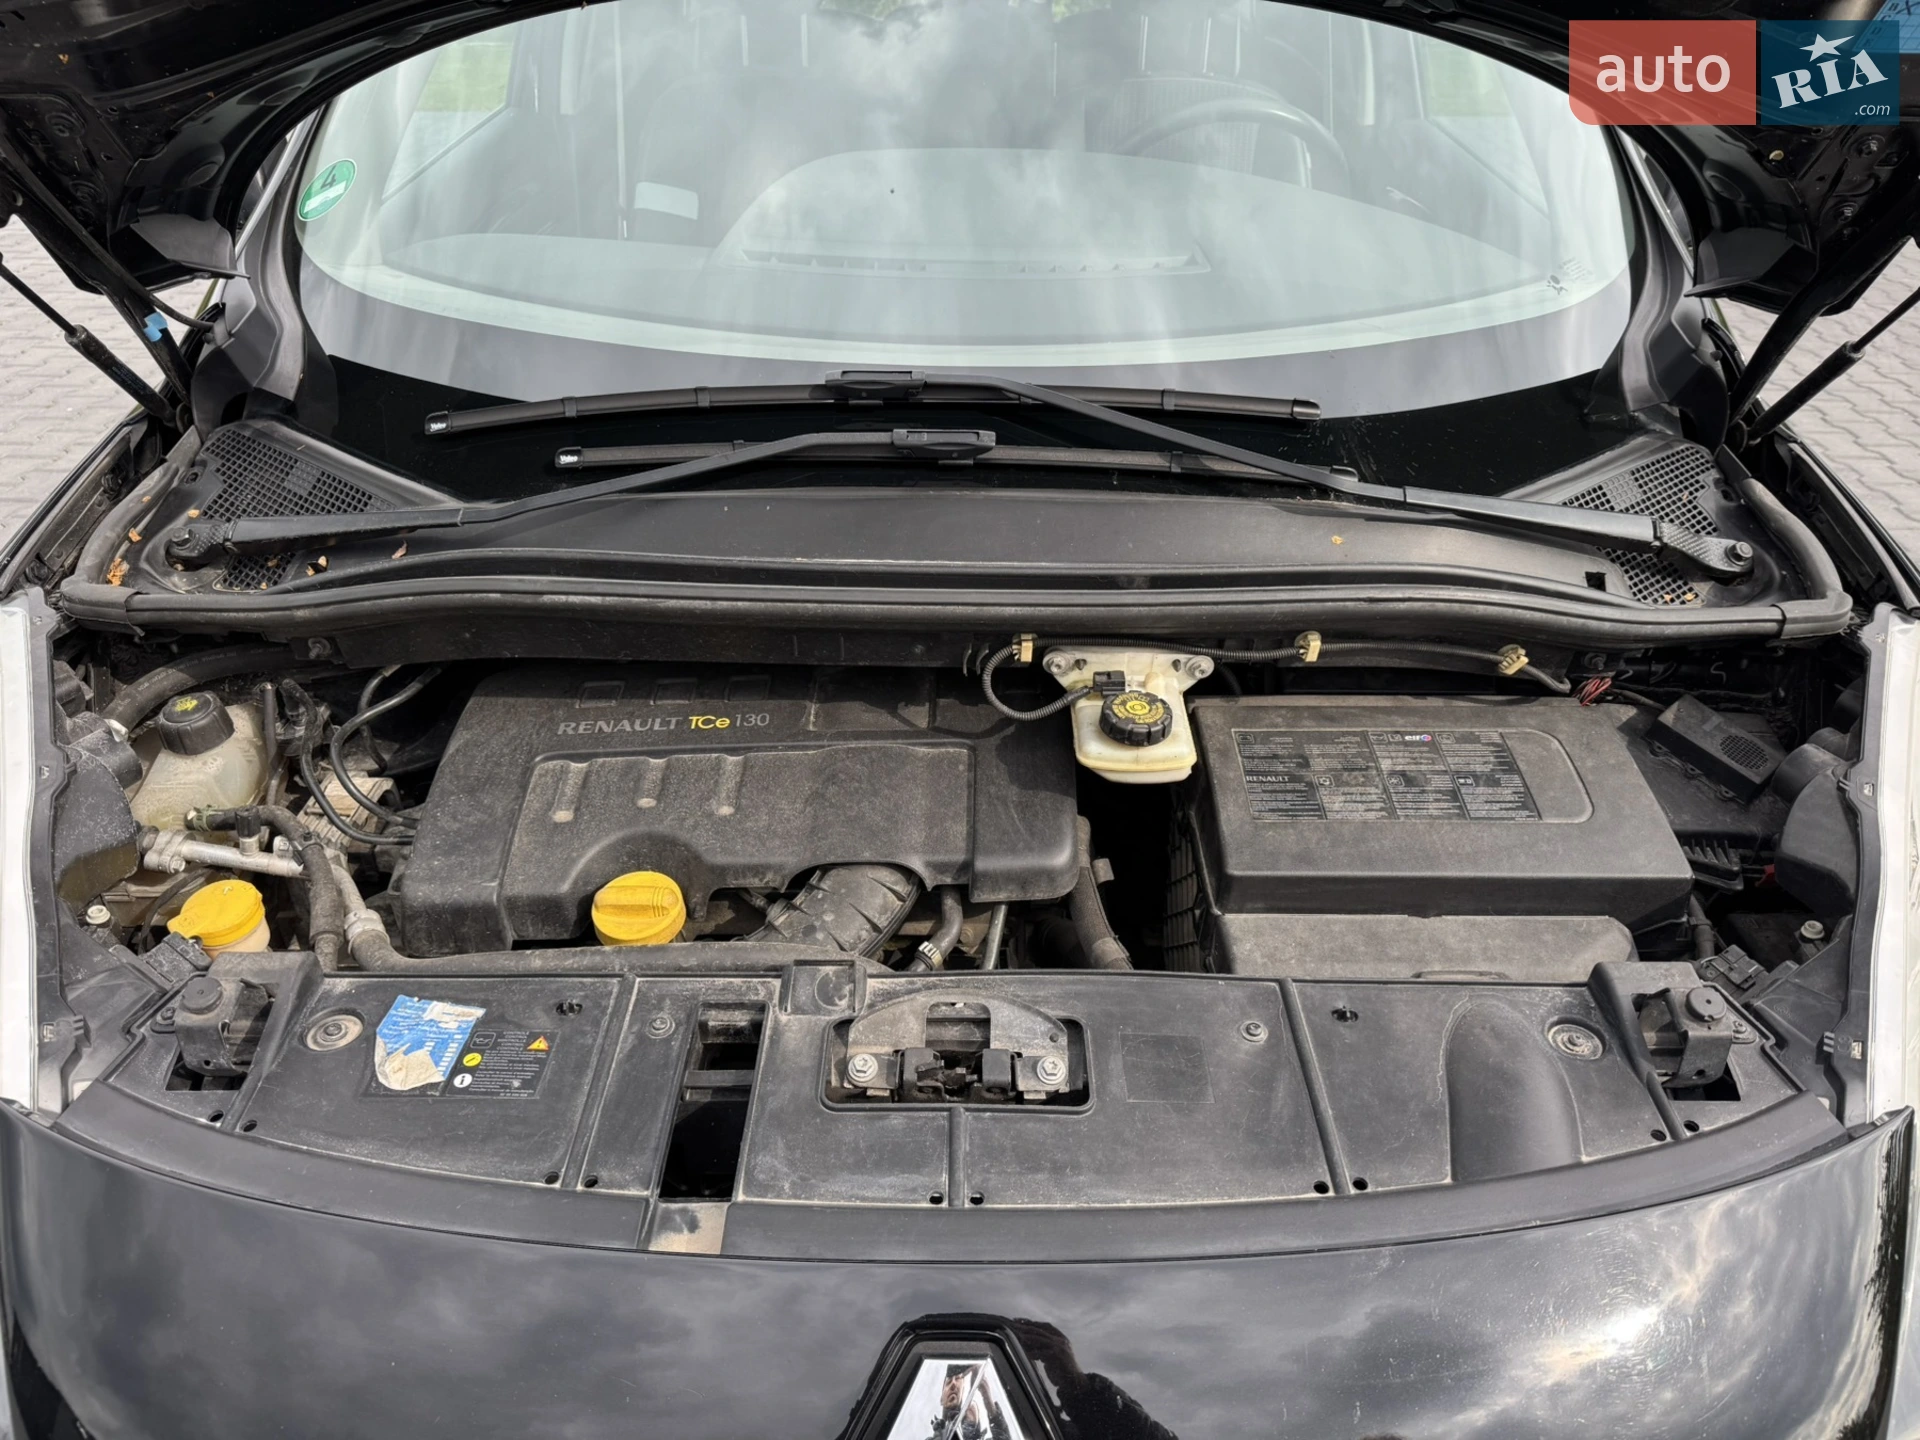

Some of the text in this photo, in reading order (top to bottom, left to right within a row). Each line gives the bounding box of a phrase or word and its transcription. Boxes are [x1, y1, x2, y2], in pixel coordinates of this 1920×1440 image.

[320, 164, 337, 190] 4
[557, 713, 770, 735] RENAULT TCe 130
